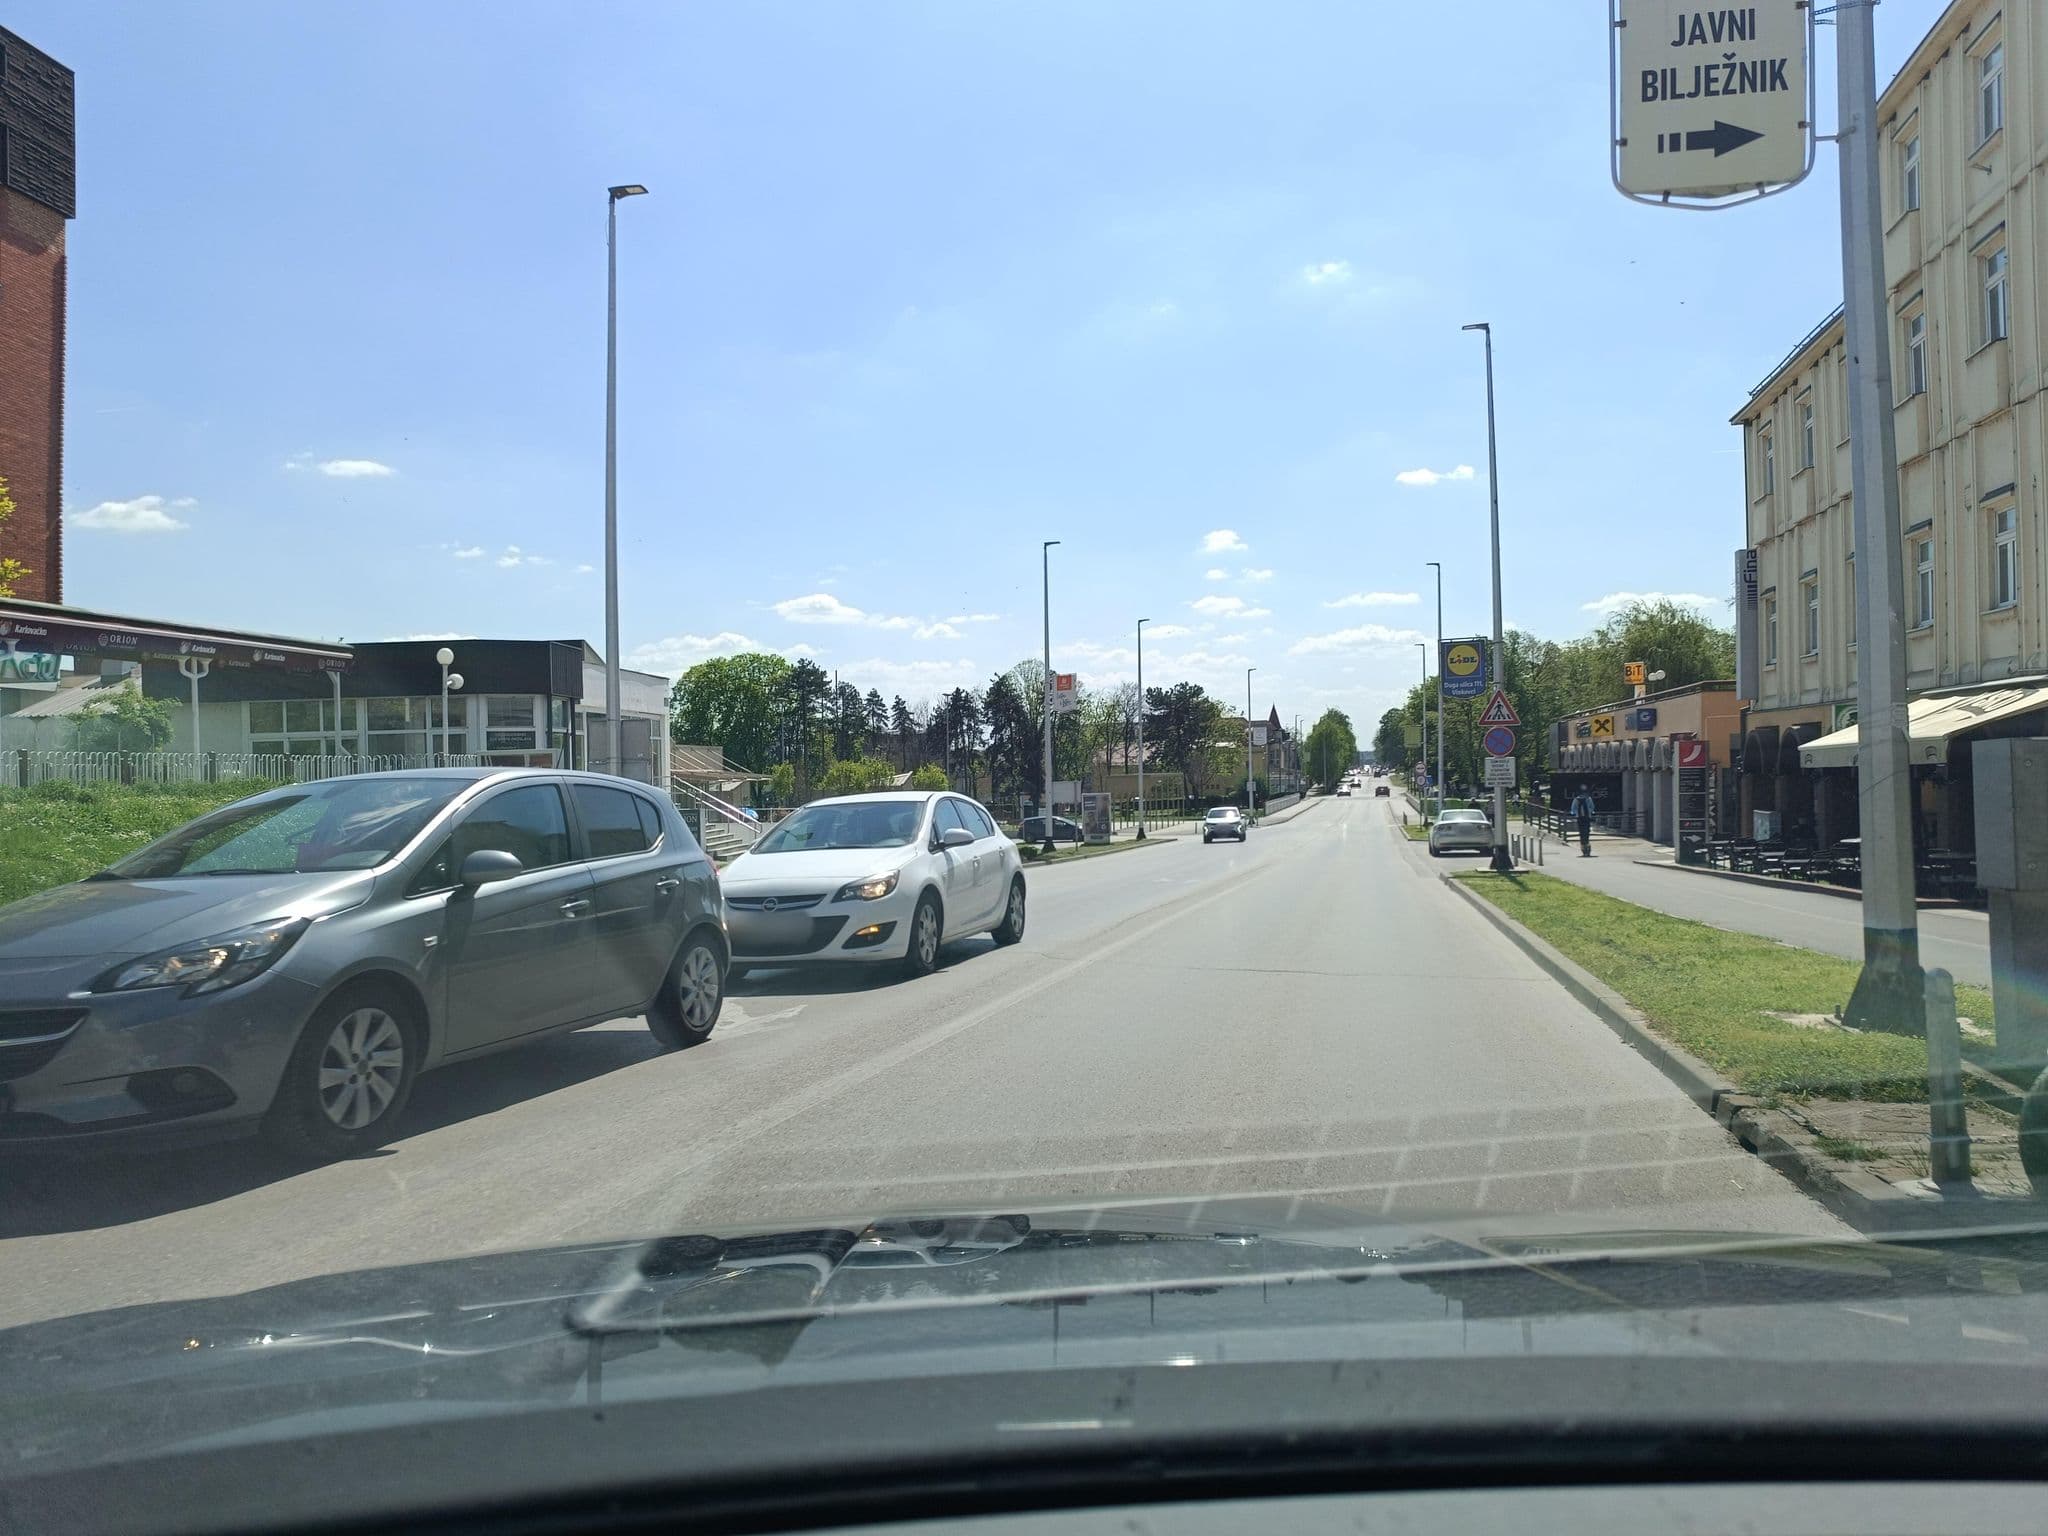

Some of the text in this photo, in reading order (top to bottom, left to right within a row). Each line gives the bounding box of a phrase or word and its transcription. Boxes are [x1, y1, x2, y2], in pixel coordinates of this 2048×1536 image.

[1670, 8, 1756, 47] JAVNI
[1641, 52, 1789, 102] BILJEŽNIK
[109, 634, 139, 645] ORION
